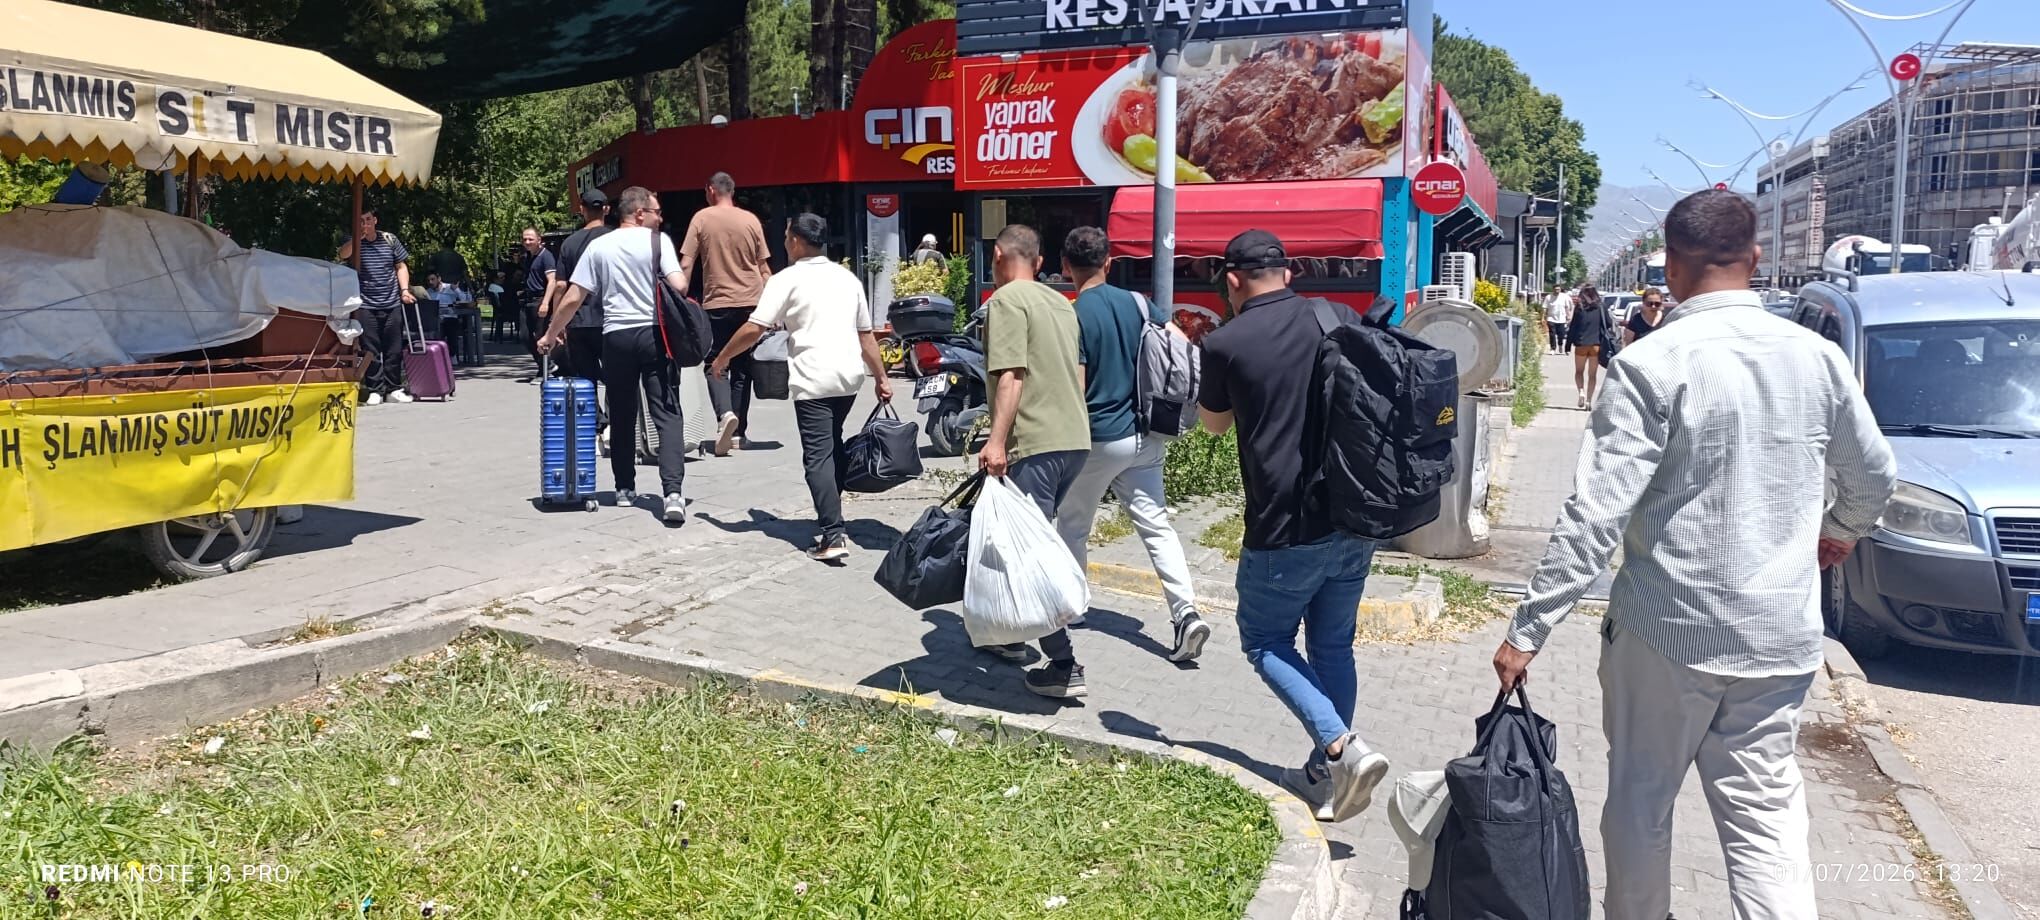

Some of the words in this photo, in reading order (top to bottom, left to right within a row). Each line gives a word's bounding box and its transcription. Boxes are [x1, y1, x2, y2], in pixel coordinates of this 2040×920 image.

[276, 104, 394, 154] MISIR
[984, 96, 1056, 129] yaprak
[976, 129, 1058, 162] döner
[175, 402, 224, 446] SÜT
